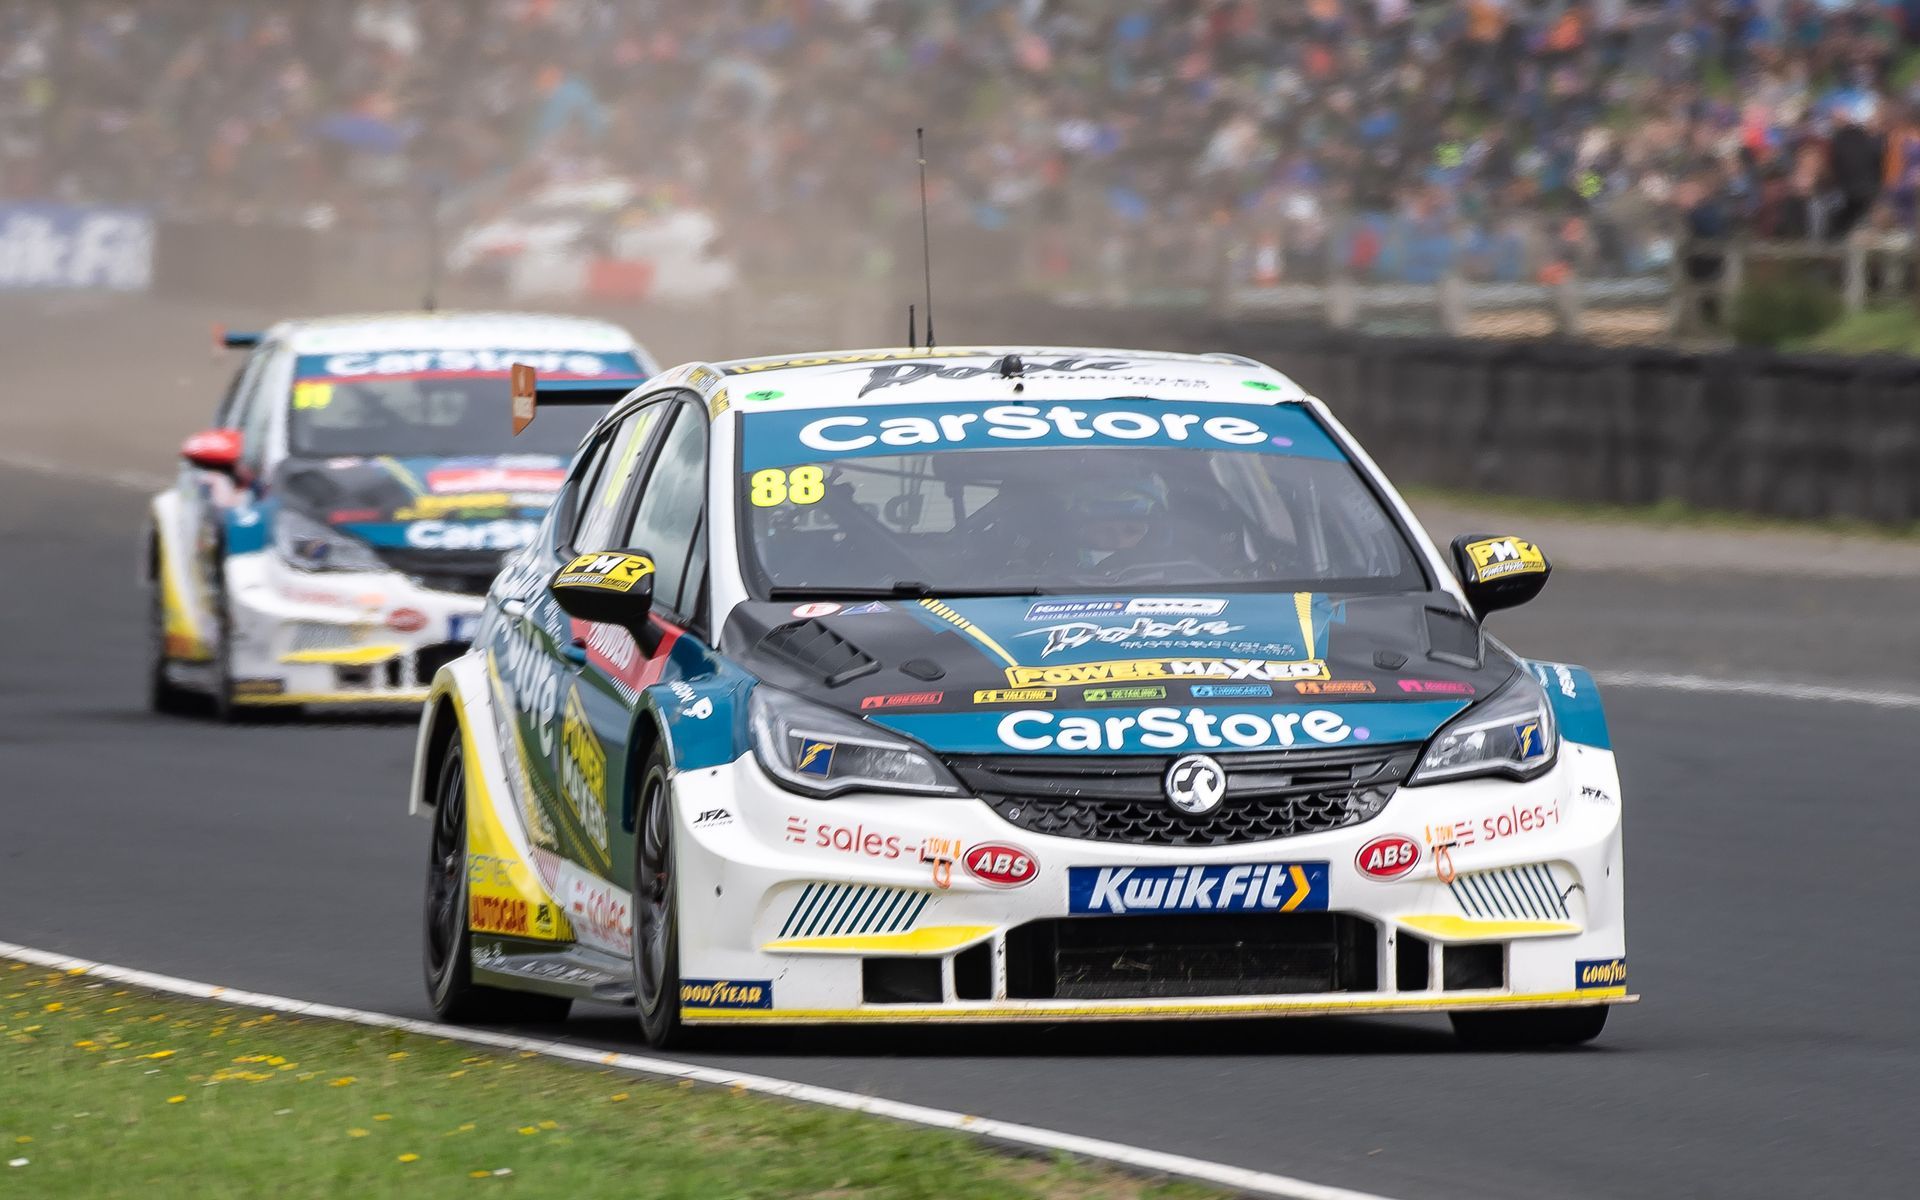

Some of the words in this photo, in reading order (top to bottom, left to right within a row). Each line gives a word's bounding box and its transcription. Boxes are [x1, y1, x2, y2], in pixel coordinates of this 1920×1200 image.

[751, 466, 825, 507] 88
[1015, 663, 1168, 684] POWER
[973, 849, 1030, 878] ABS
[1366, 841, 1416, 871] ABS
